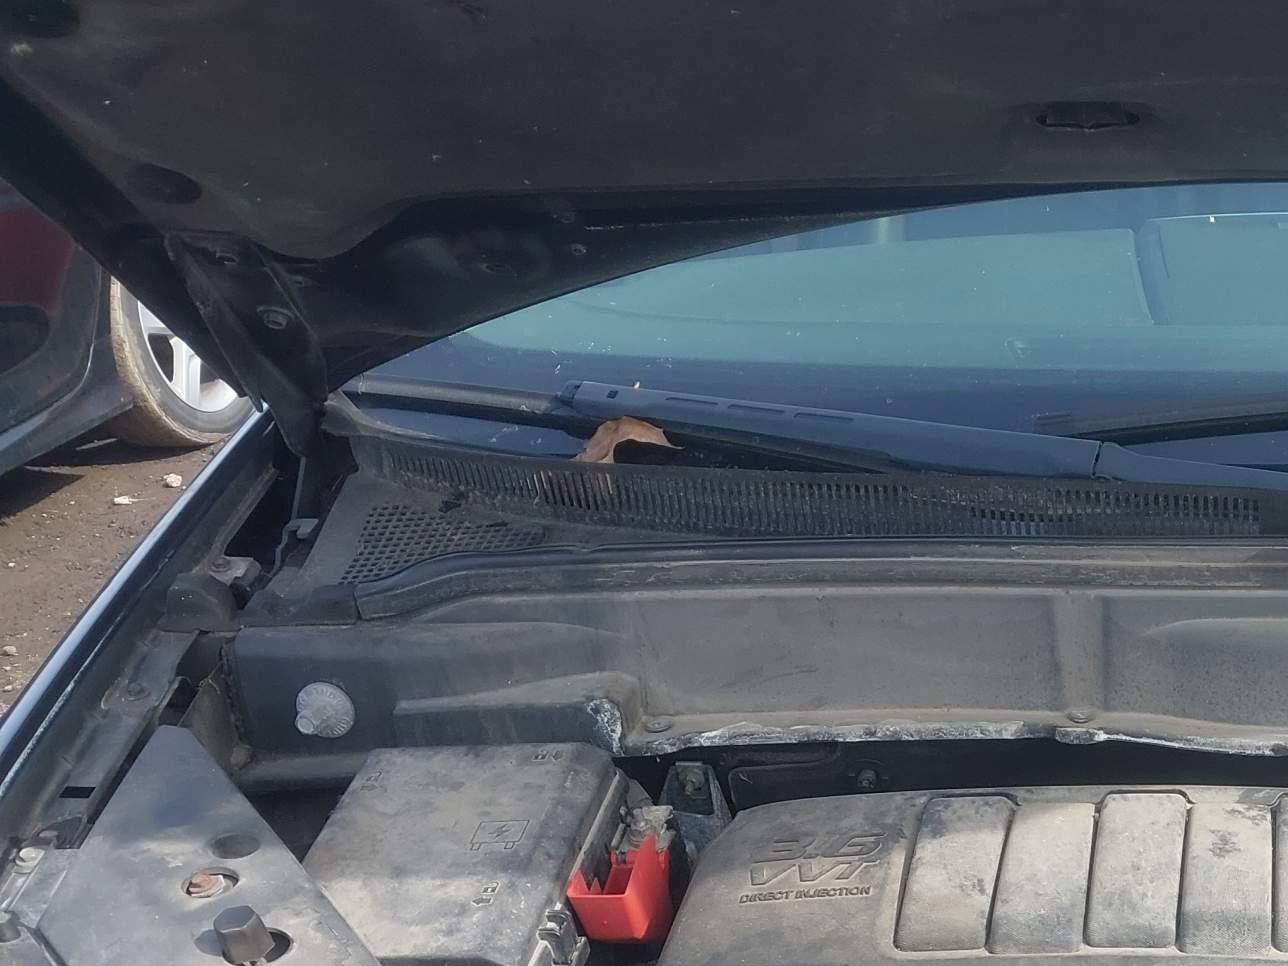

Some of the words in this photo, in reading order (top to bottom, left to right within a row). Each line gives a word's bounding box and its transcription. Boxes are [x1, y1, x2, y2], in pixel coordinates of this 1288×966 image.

[751, 831, 888, 864] 3.6
[750, 859, 881, 887] VVT
[739, 890, 793, 904] DIRECT
[795, 885, 873, 900] INJECTION
